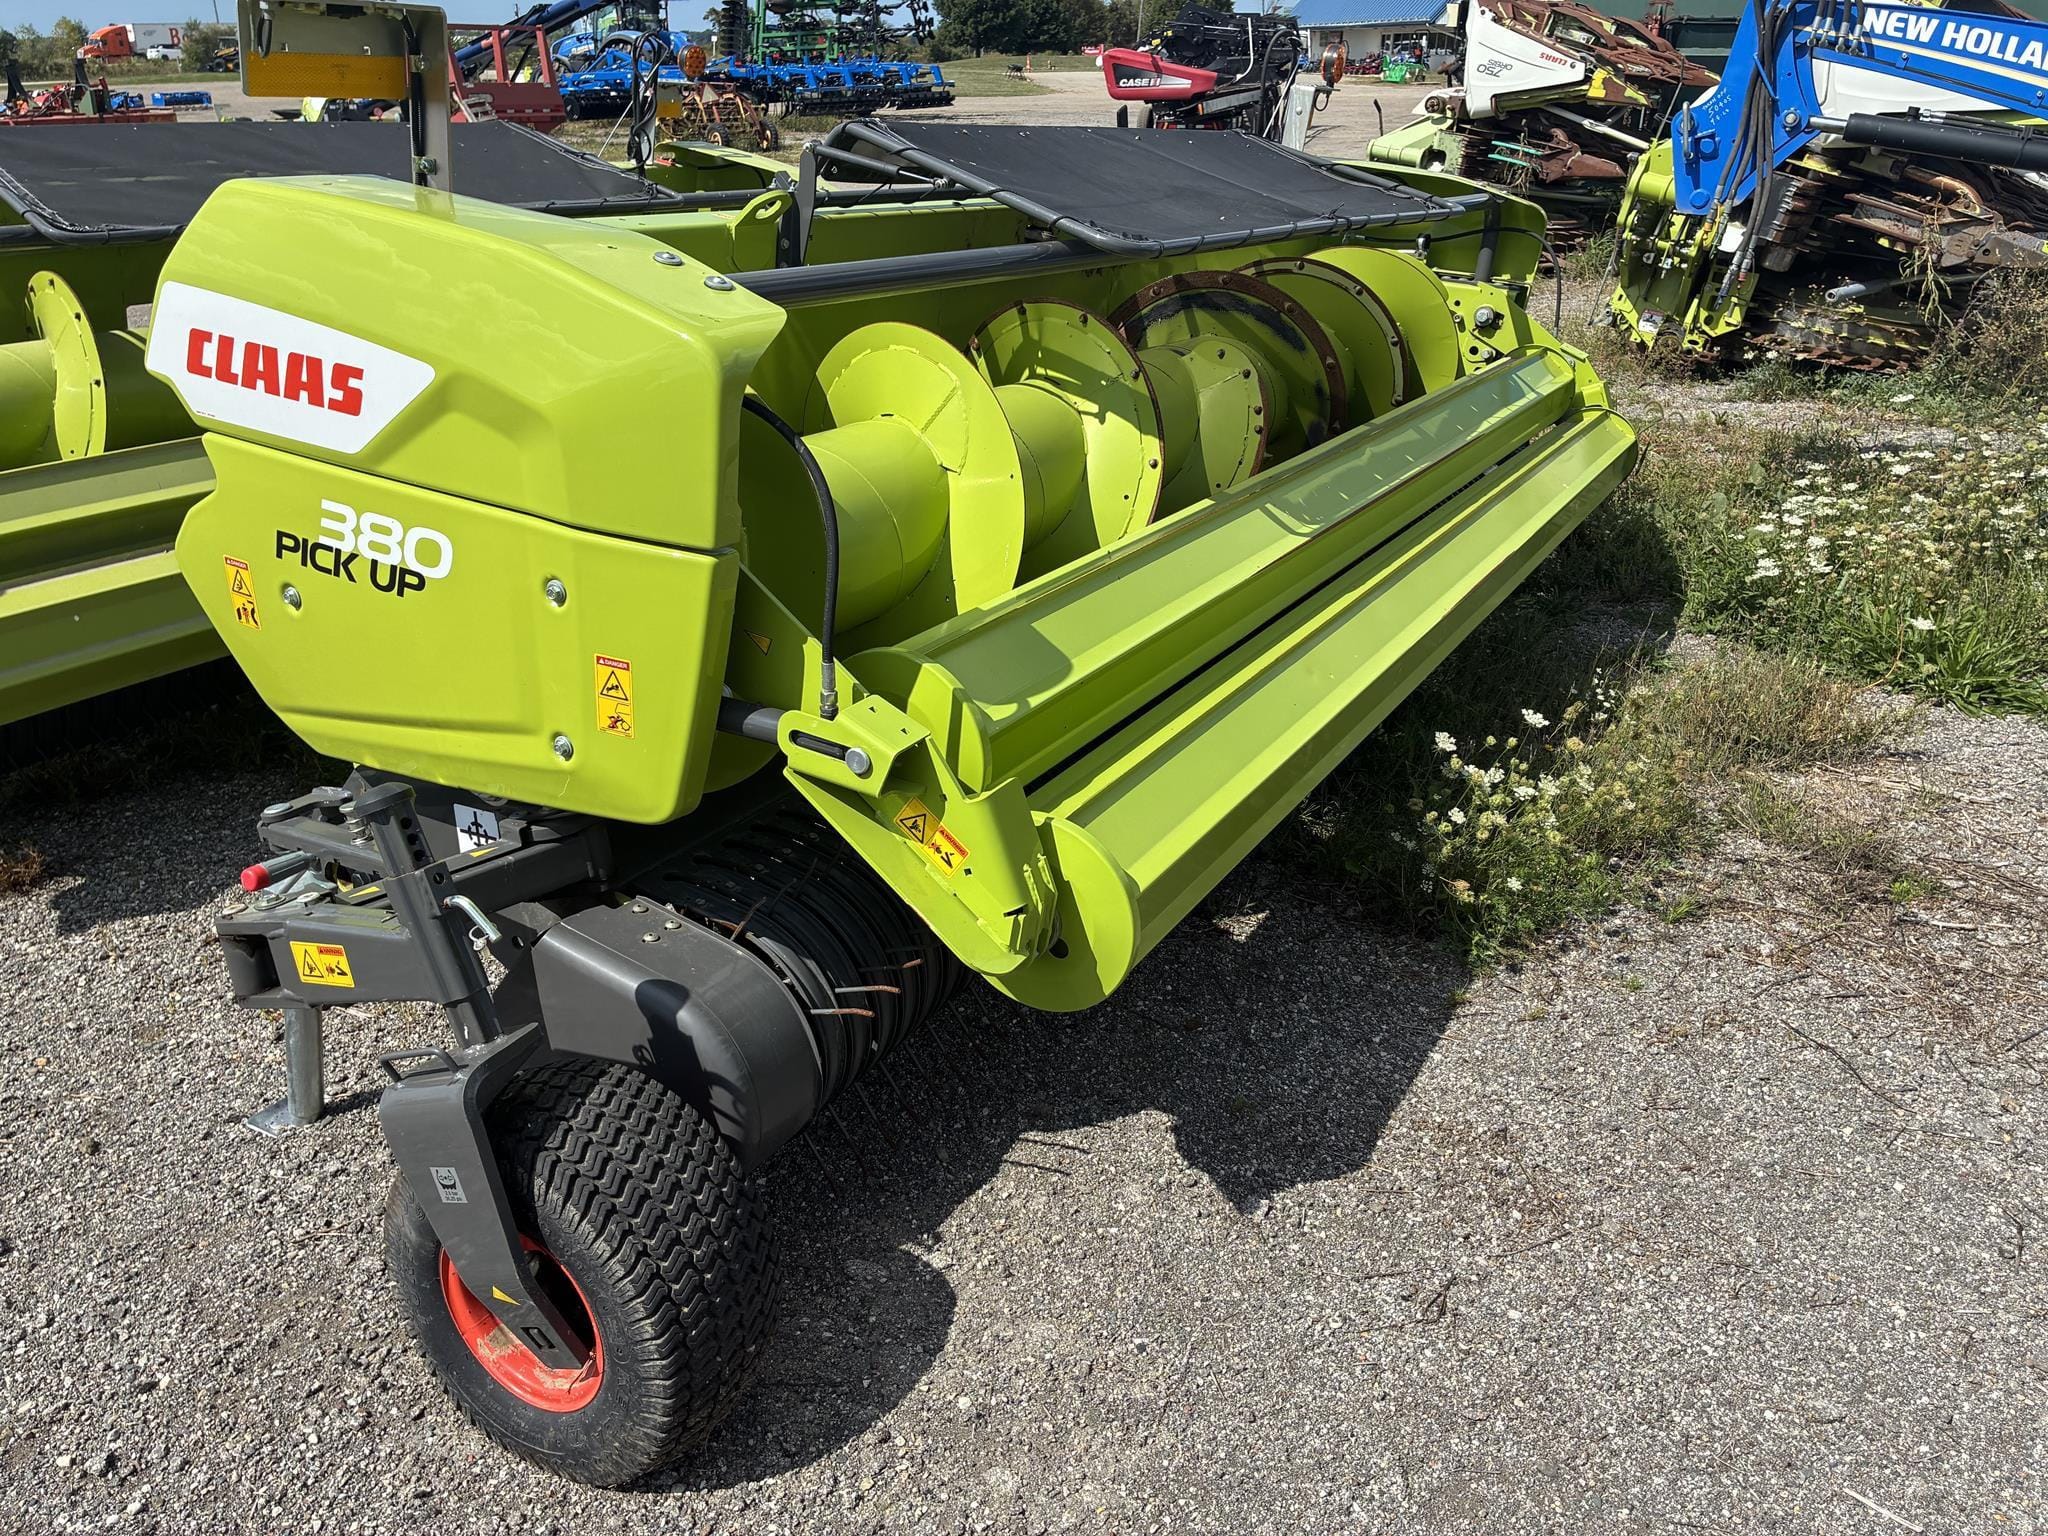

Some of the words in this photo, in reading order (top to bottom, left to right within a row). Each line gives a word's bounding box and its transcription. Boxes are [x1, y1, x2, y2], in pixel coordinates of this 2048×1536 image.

[1863, 7, 1940, 43] NEW
[1940, 21, 2048, 71] HOLLA
[1486, 59, 1513, 71] ORBIS
[1539, 52, 1568, 66] CLAAS
[1476, 63, 1503, 78] 750
[1119, 78, 1150, 87] CASE
[187, 327, 365, 417] CLAAS
[318, 498, 454, 579] 380
[275, 529, 360, 584] PICK
[369, 557, 427, 598] UP
[603, 659, 628, 669] DANGER
